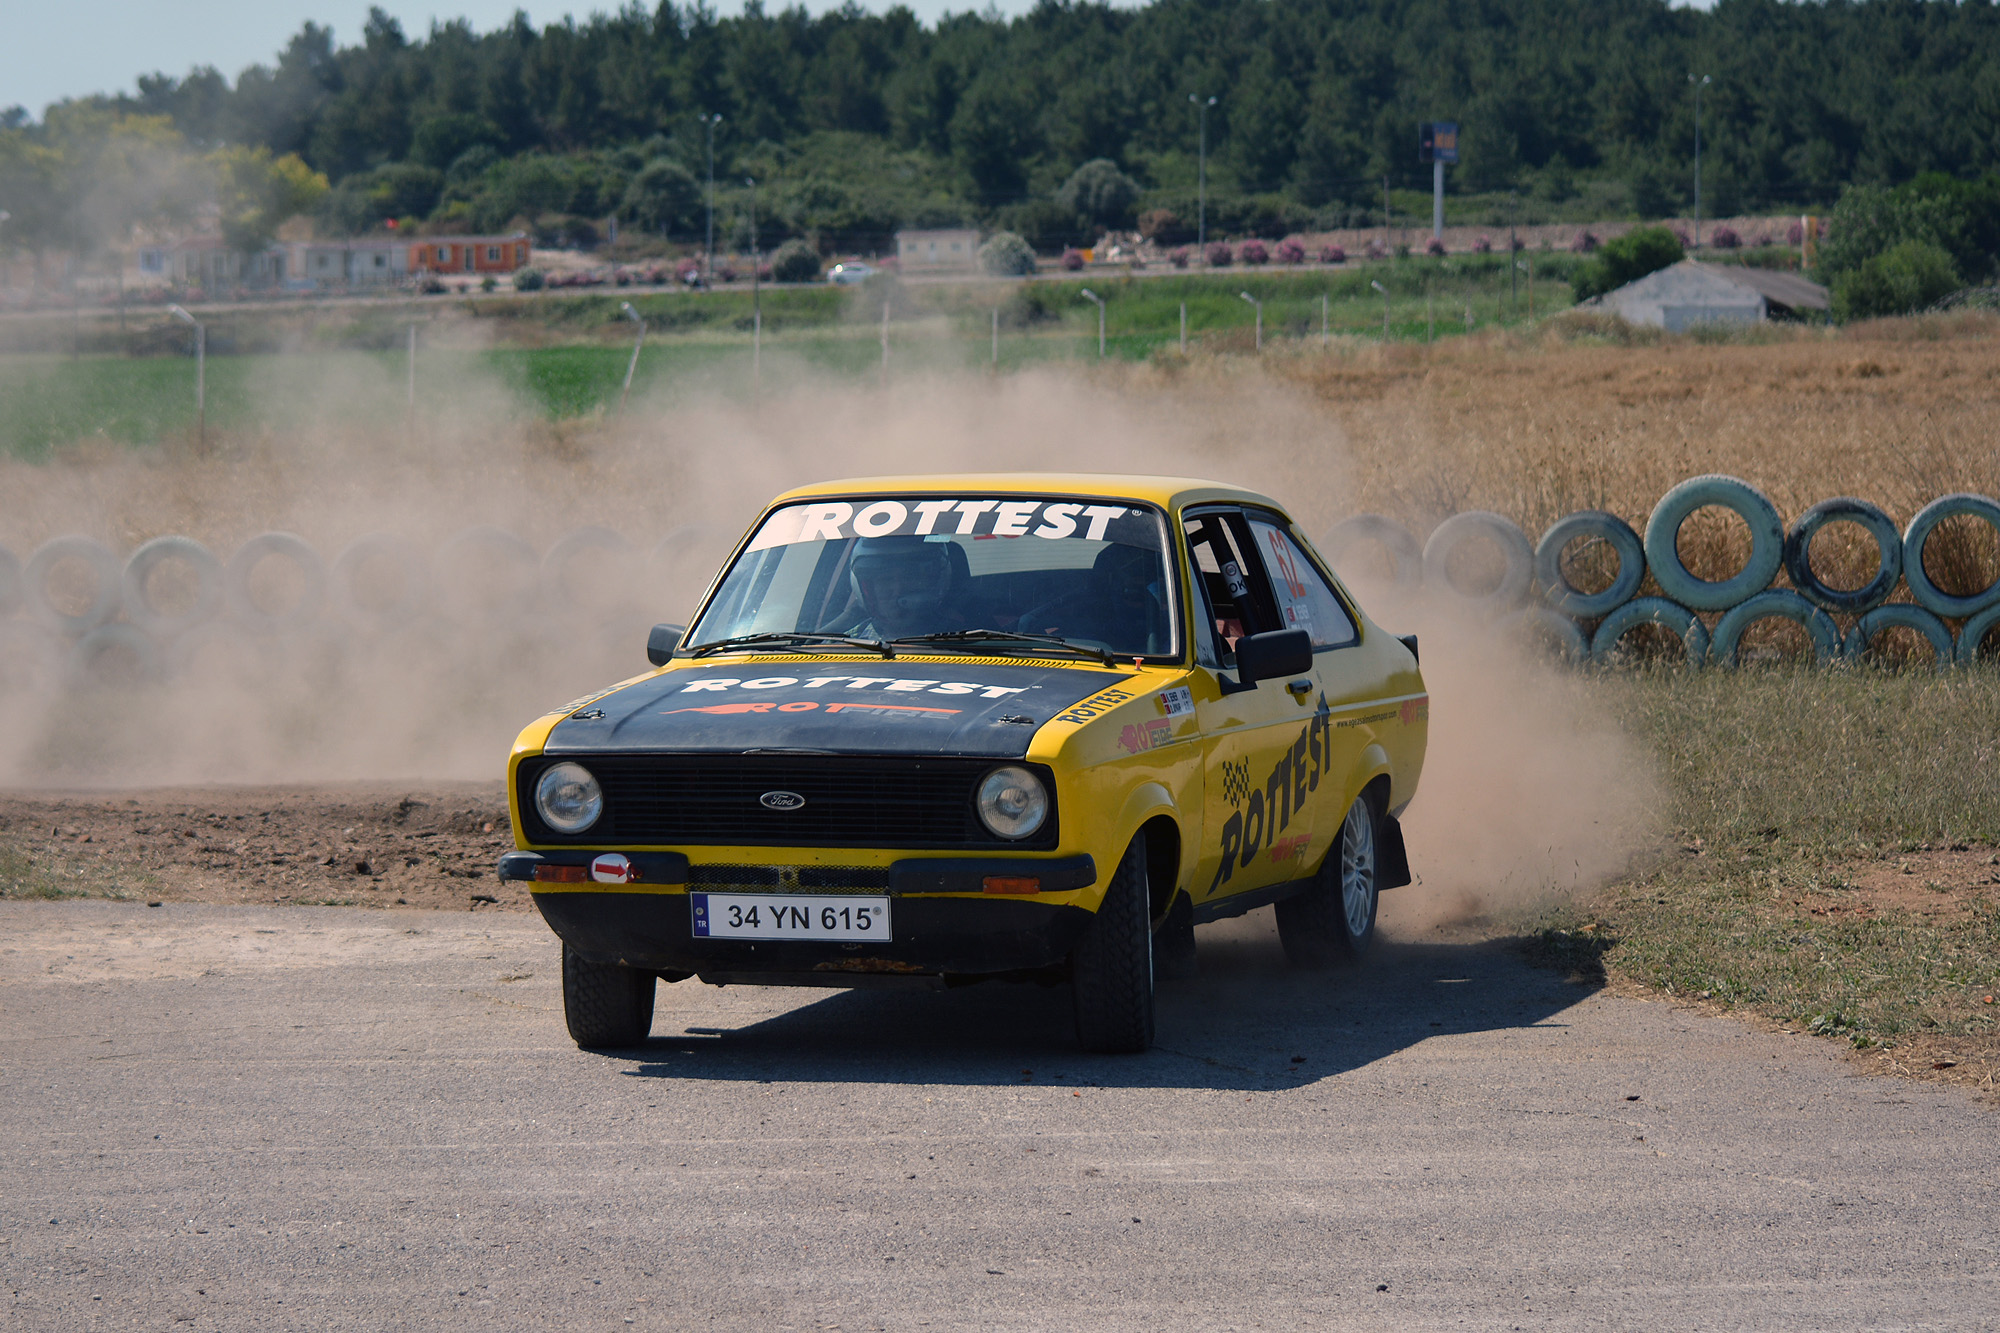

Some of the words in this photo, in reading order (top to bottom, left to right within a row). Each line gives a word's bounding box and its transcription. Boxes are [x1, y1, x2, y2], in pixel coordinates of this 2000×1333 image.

[798, 500, 1128, 540] ROTTEST
[1229, 579, 1247, 594] OK
[680, 676, 1032, 699] ROTTEST
[1056, 690, 1135, 725] ROTTEST
[770, 794, 795, 806] Ford
[1206, 689, 1331, 897] ROTTEST
[697, 919, 707, 928] TR
[728, 904, 761, 928] 34
[769, 905, 811, 930] YN
[821, 906, 873, 931] 615
